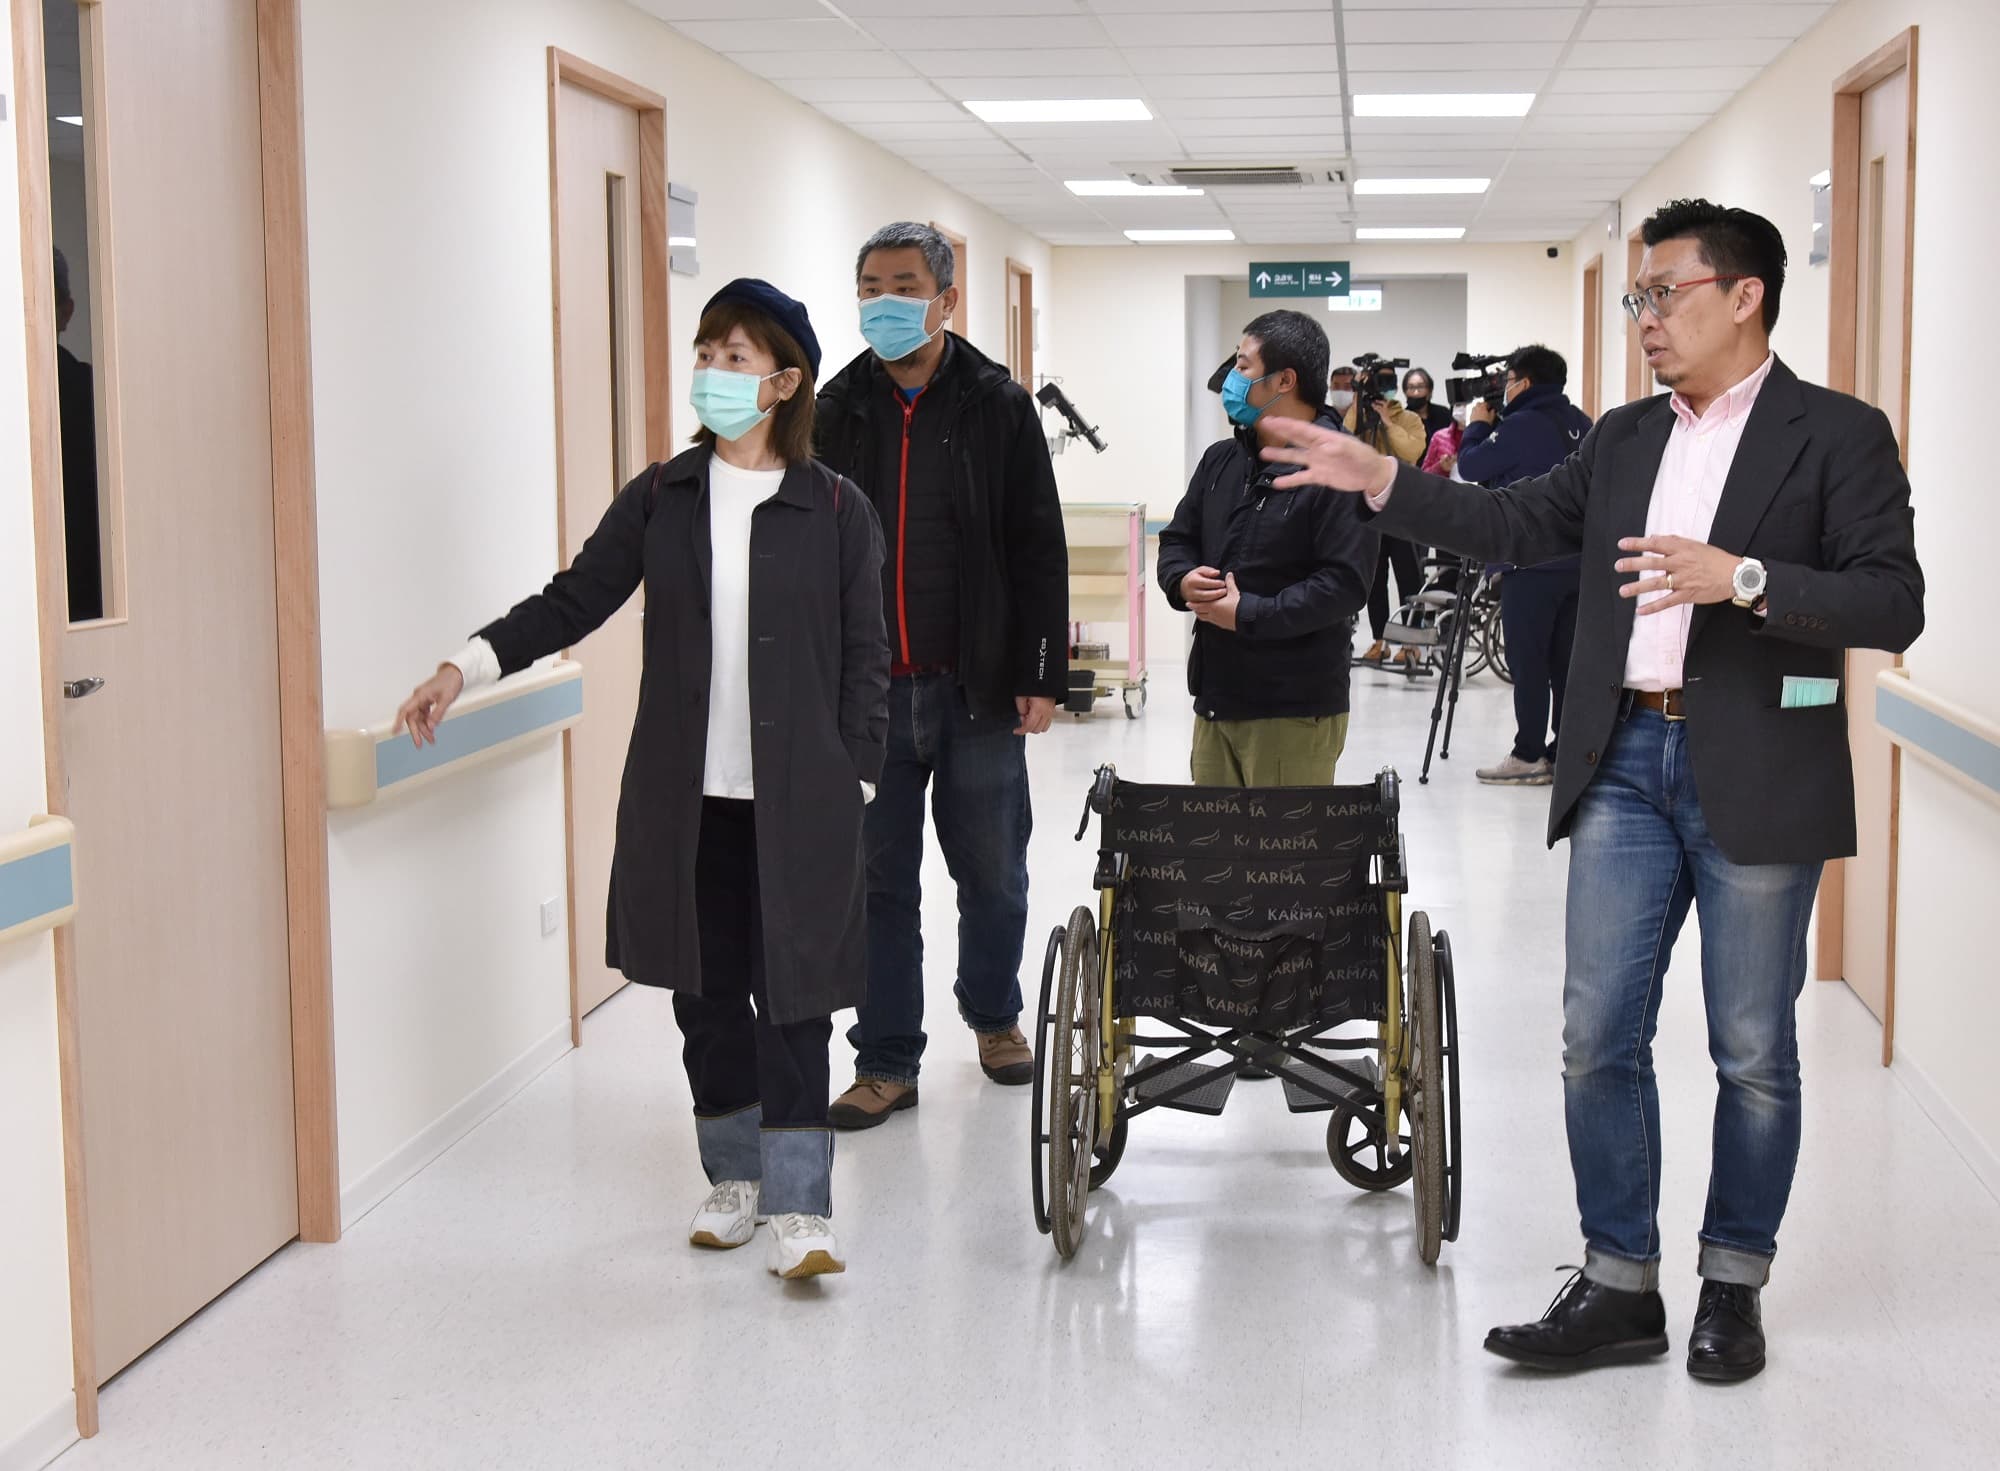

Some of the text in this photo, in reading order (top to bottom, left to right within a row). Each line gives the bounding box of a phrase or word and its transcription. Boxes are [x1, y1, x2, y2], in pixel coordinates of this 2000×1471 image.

[1183, 800, 1241, 813] KARMA
[1326, 803, 1382, 817] KARMA
[1117, 829, 1175, 843] KARMA
[1259, 836, 1318, 850] KARMA
[1130, 865, 1187, 881] KARMA
[1246, 870, 1306, 885] KARMA
[1267, 908, 1325, 921] KARMA
[1134, 929, 1177, 946] KARM
[1214, 934, 1264, 959] KARMA
[1206, 995, 1259, 1016] KARMA
